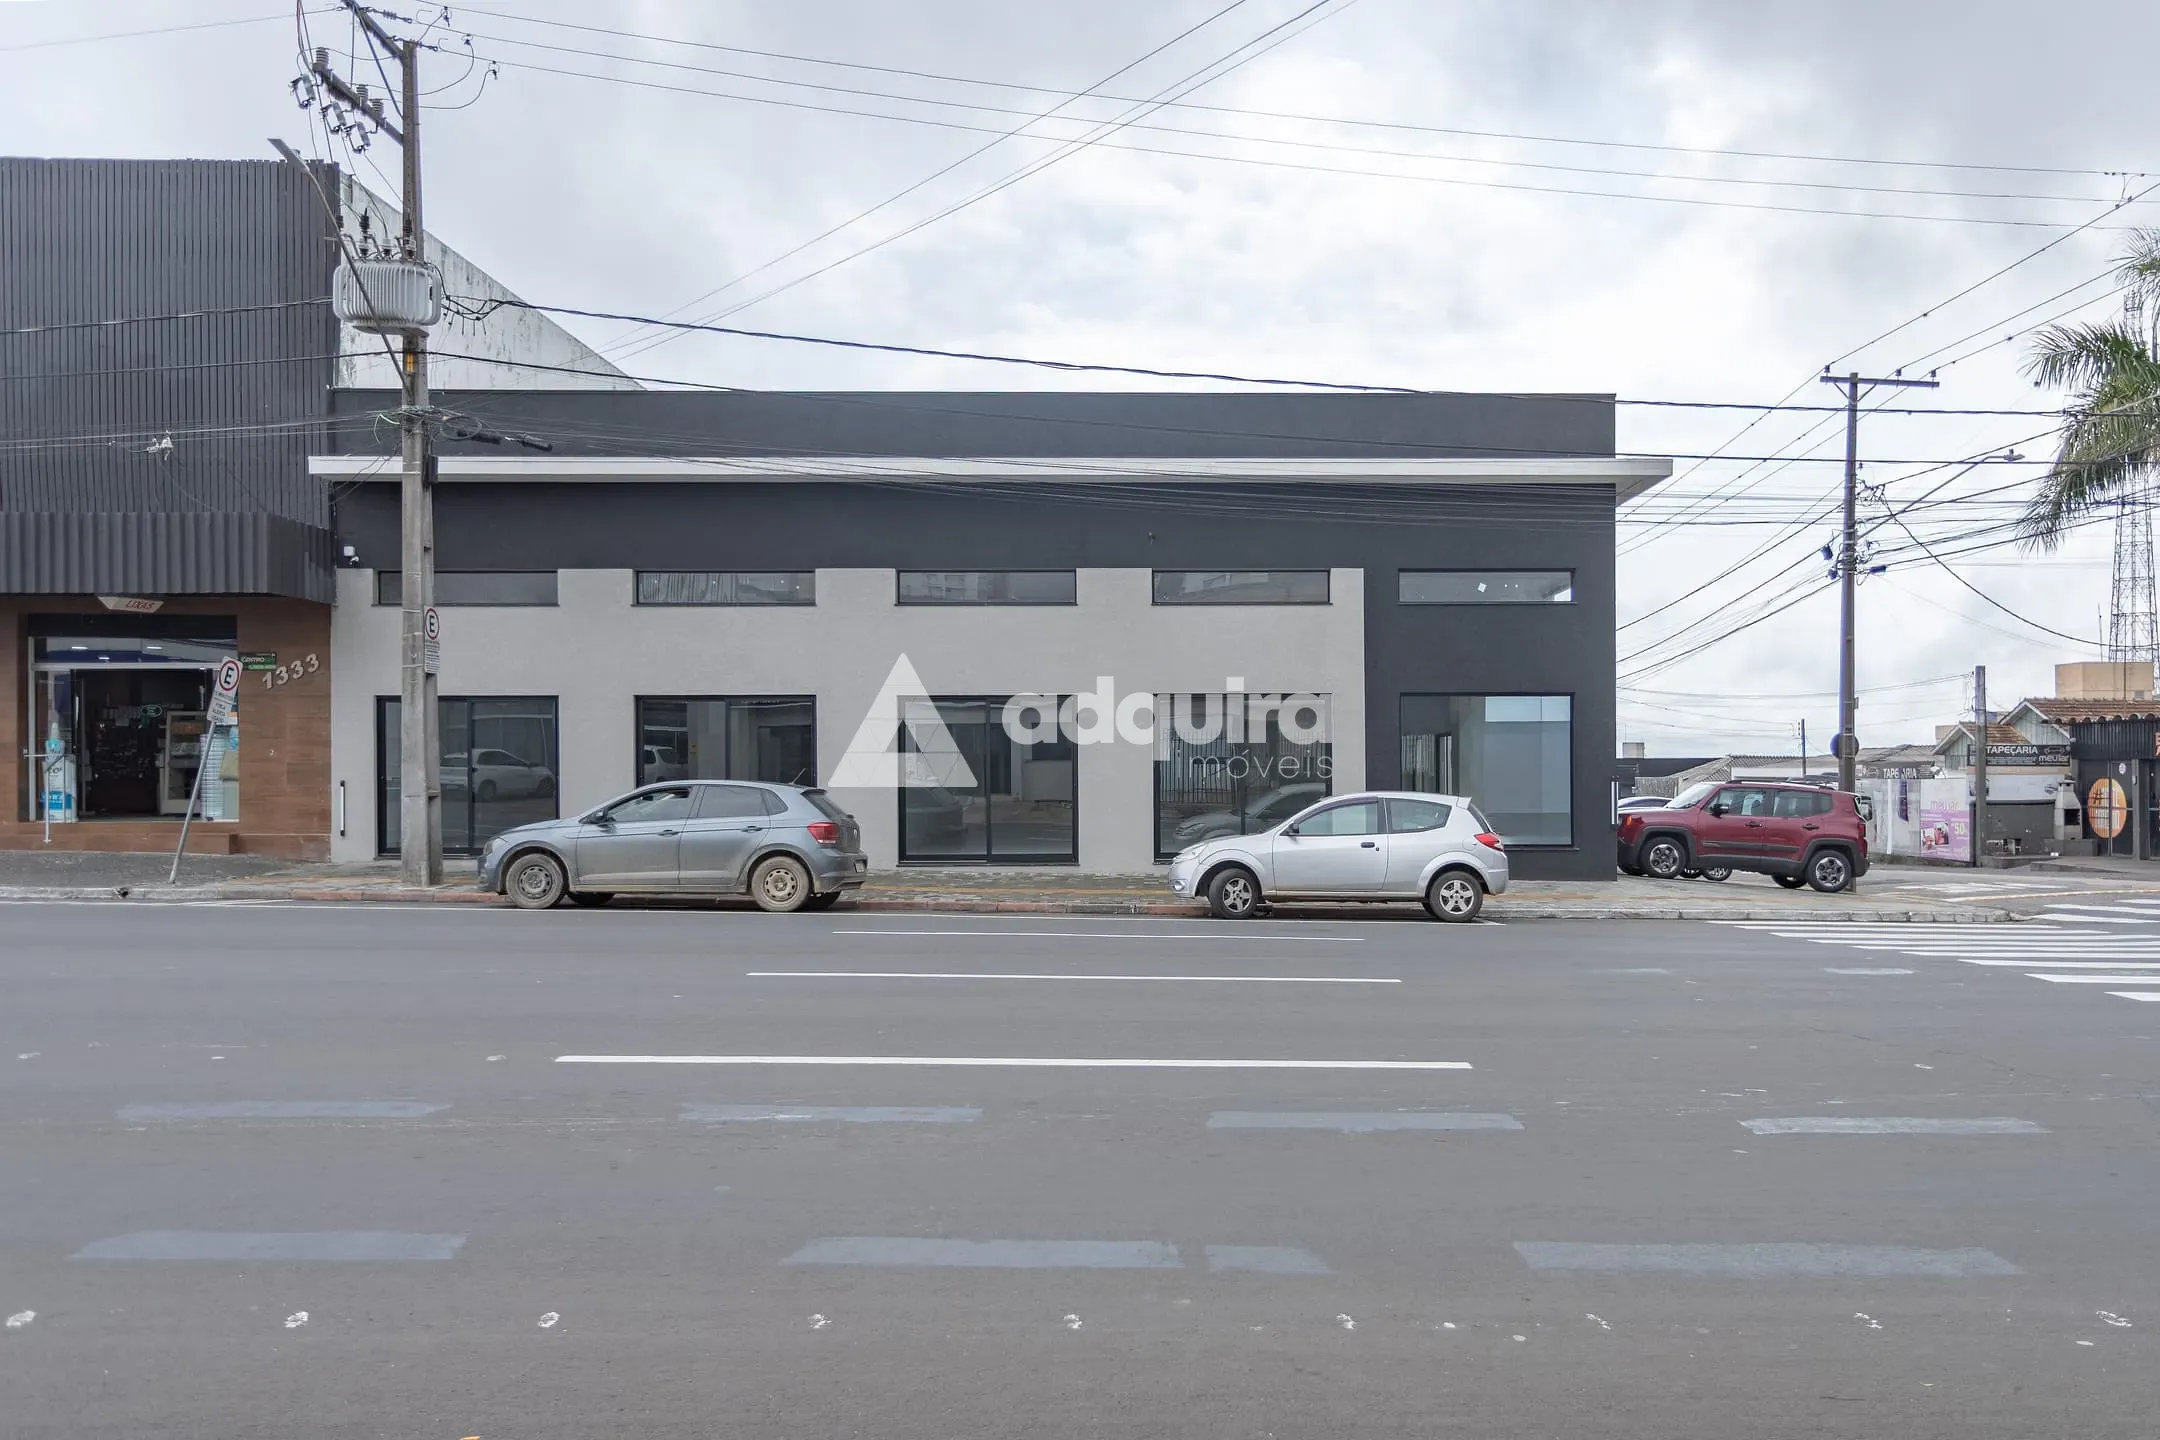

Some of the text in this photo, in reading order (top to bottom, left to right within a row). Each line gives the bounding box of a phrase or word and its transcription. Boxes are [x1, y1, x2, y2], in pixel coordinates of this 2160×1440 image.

[429, 614, 436, 633] E
[223, 666, 235, 685] E
[262, 653, 319, 689] 1333
[1986, 745, 2038, 756] TAPEÇARIA
[1883, 767, 1917, 779] TAPEARIA
